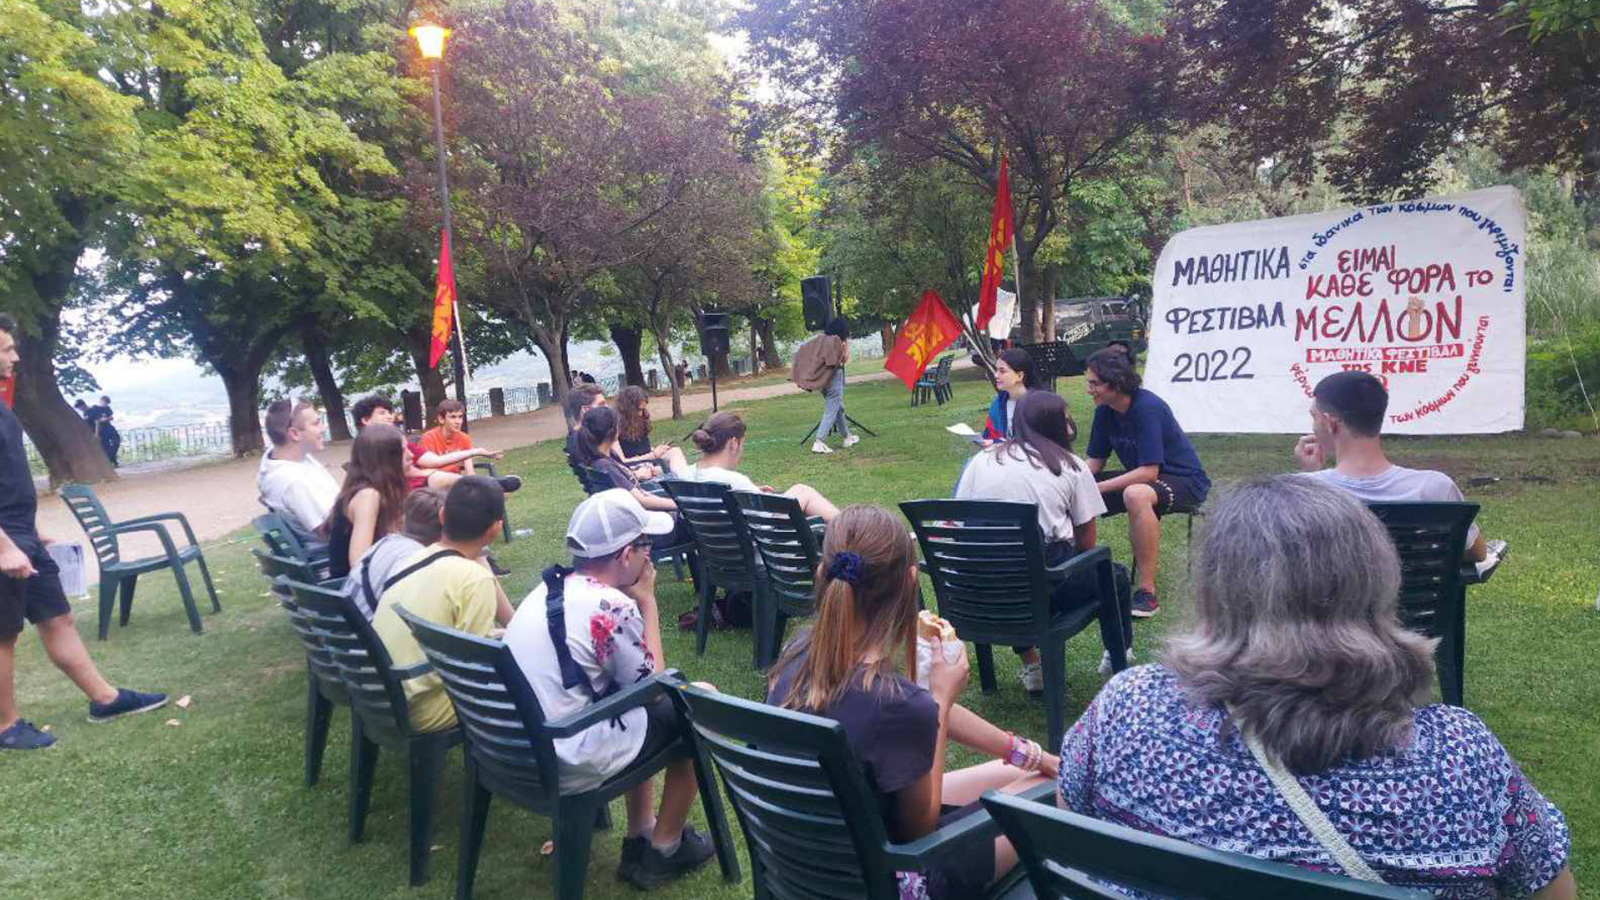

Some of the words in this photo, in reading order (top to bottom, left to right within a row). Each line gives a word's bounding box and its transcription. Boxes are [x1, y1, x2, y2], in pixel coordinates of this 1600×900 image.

[1367, 204, 1393, 215] των
[1459, 206, 1482, 222] που
[1172, 246, 1290, 287] ΜΑΘΗΤΙΚΑ
[1337, 244, 1395, 274] ΕΙΜΑΙ
[1306, 272, 1373, 300] ΚΑΘΕ
[1387, 263, 1456, 295] ΦΟΡΑ
[1465, 270, 1494, 287] ΤΟ
[1165, 301, 1286, 334] ΦΕΣΤΙΒΑΛ
[1294, 295, 1463, 343] ΜΕΛΛΟΝ
[1171, 346, 1255, 382] 2022
[1382, 360, 1427, 373] ΚΝΕ
[1384, 345, 1459, 360] ΦΕΣΤΙΒΑΛ
[1390, 412, 1413, 423] των
[1453, 373, 1469, 391] που
